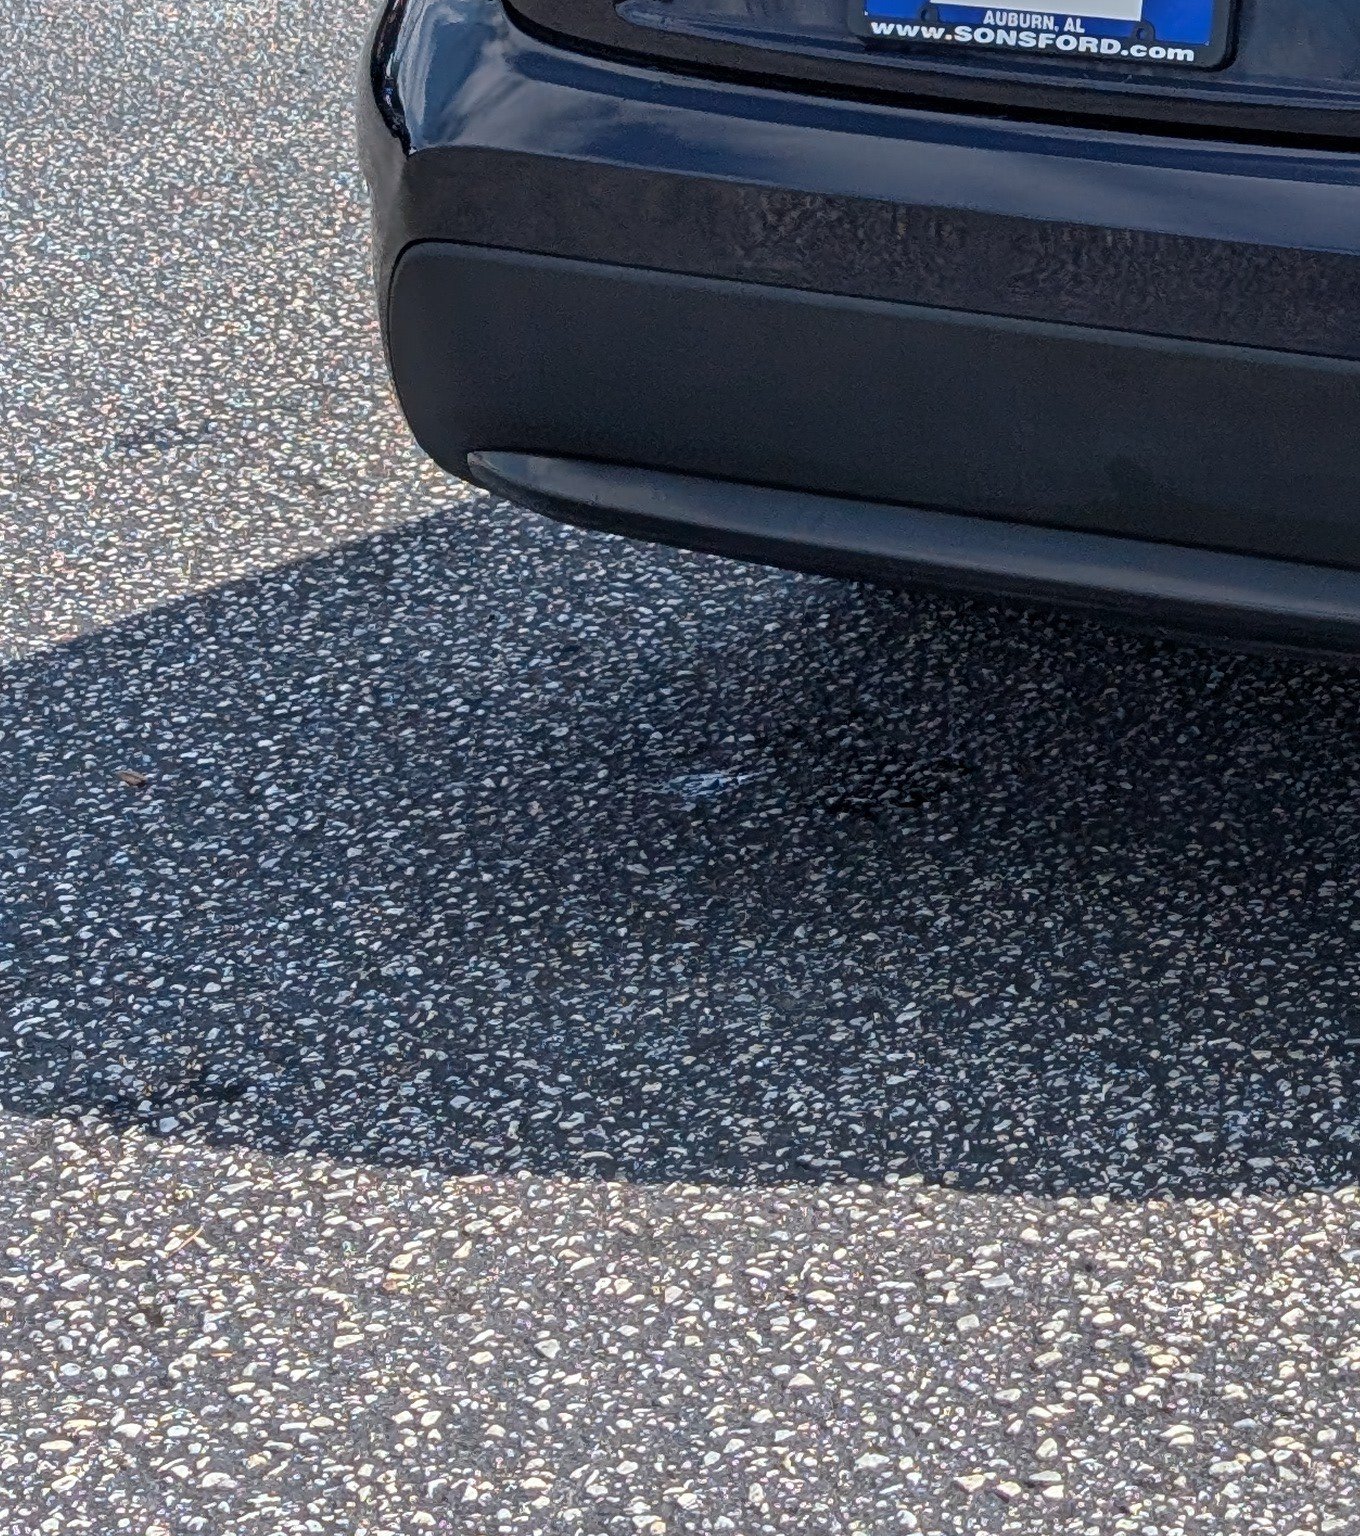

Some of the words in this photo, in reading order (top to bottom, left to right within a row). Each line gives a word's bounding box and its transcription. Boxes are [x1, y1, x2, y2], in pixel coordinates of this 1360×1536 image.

[983, 10, 1059, 33] AUBURN,
[1063, 17, 1086, 35] AL
[870, 20, 1196, 63] www.SONSFORD.com
